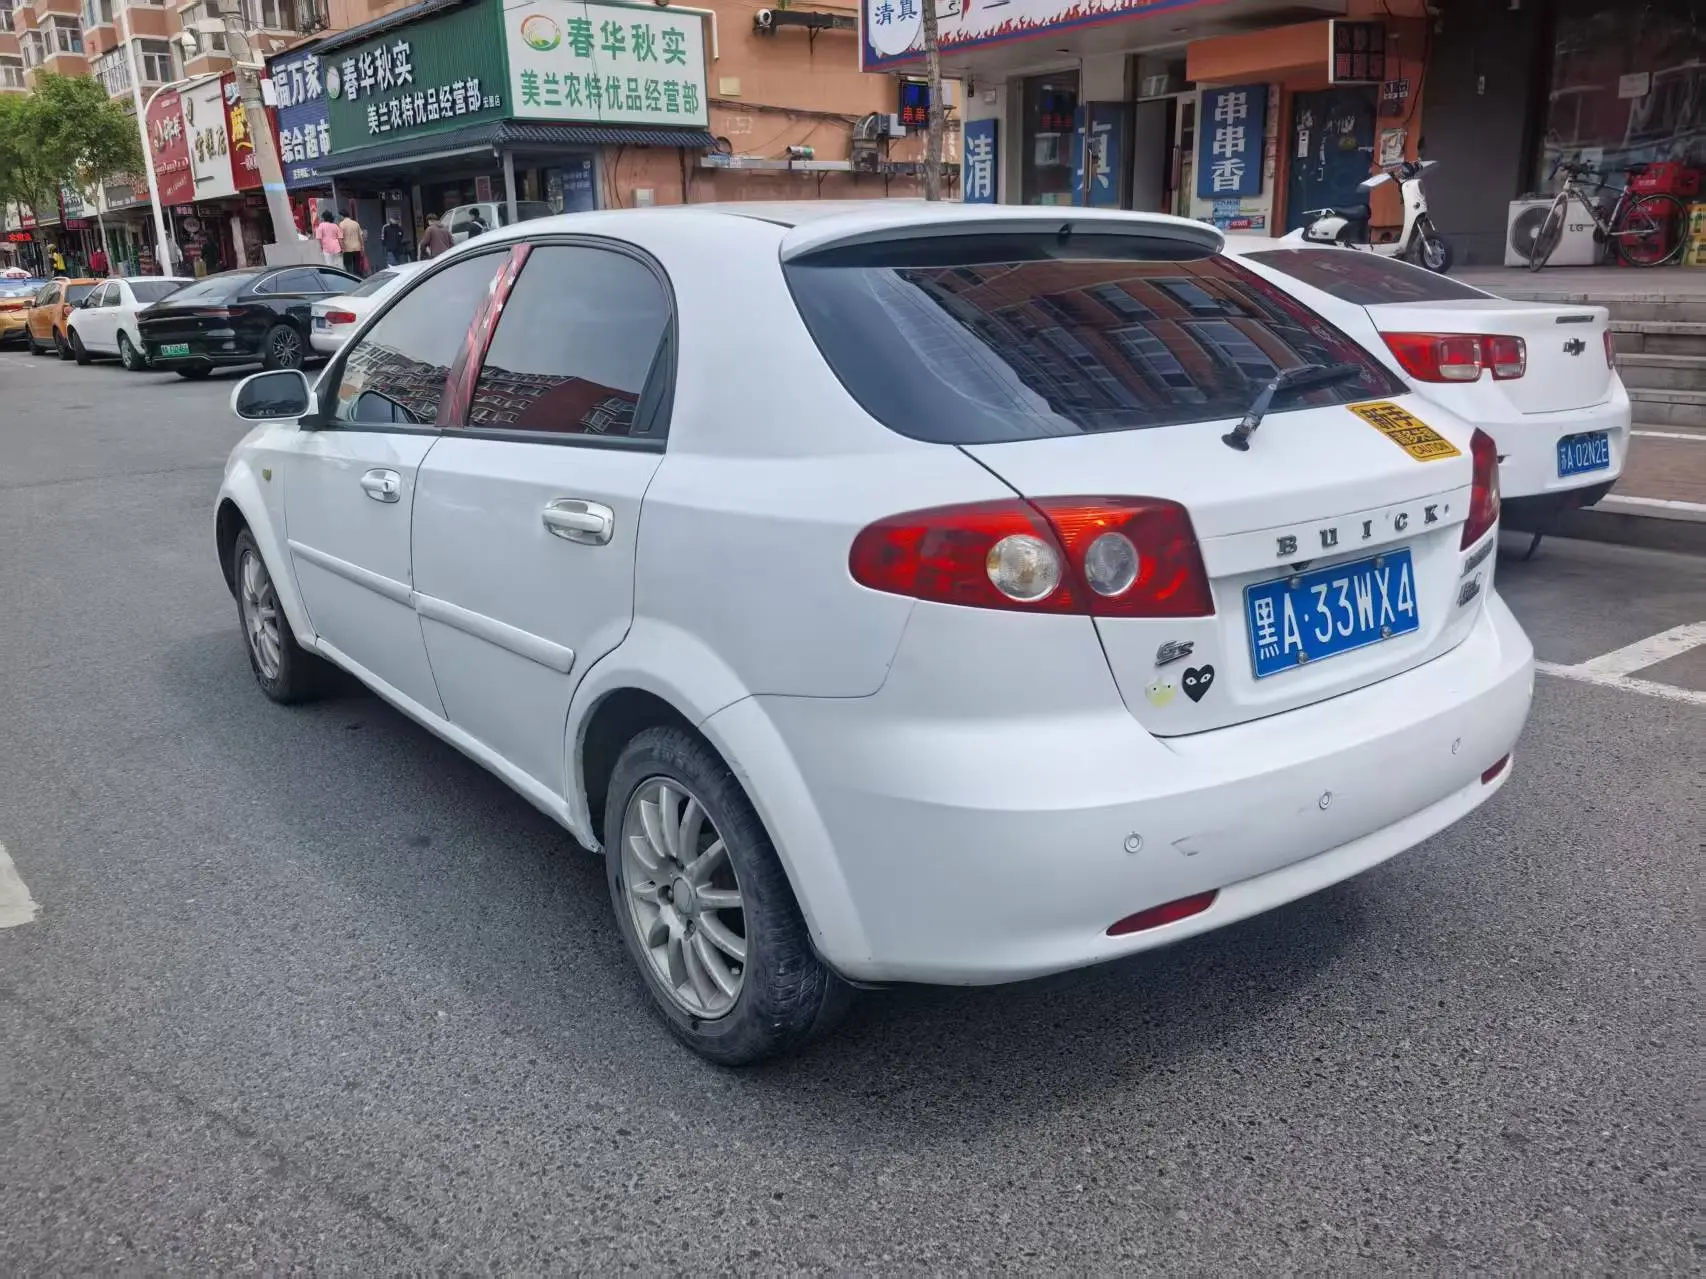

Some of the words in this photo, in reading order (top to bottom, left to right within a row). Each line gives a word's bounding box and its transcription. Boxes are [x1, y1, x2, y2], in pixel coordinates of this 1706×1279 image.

[874, 0, 918, 25] 清真
[567, 17, 687, 66] 春华秋实
[271, 53, 322, 109] 福万家
[342, 40, 413, 101] 春华秋实
[520, 68, 699, 115] 美兰农特优品经营部
[367, 76, 481, 134] 美兰农特优品经营部
[280, 118, 332, 164] 综合超市
[966, 133, 994, 199] 清
[1076, 120, 1113, 191] 真
[1211, 92, 1248, 192] 串串香
[1360, 405, 1413, 430] 新手
[1276, 504, 1438, 557] BUICK
[1254, 562, 1415, 661] 黑A·33WX4
